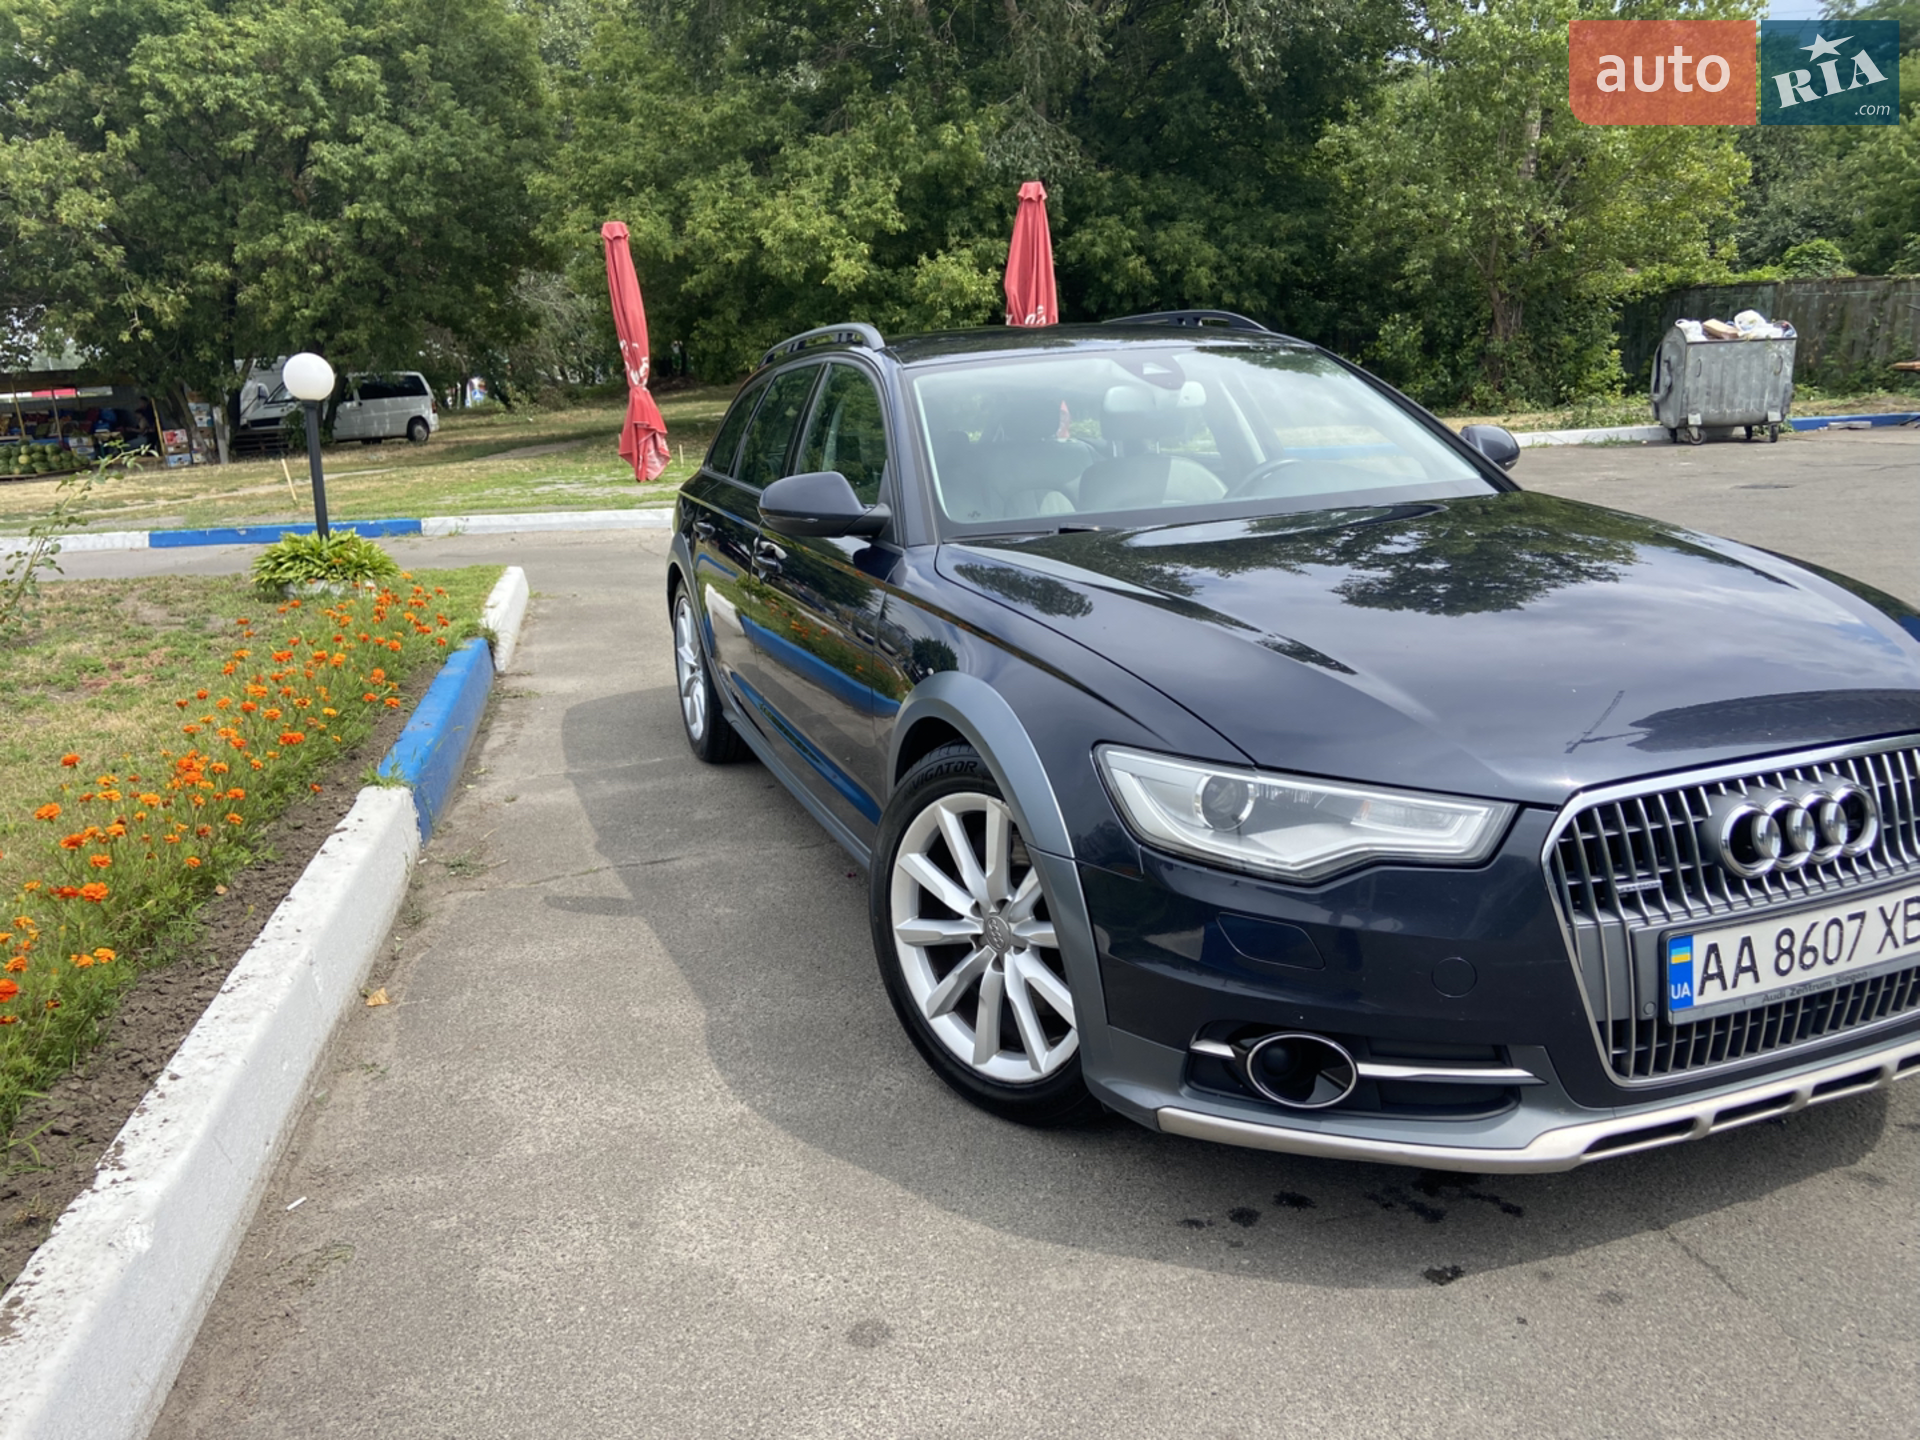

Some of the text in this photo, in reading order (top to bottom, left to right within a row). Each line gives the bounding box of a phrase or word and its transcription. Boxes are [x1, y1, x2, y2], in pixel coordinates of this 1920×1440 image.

[1698, 935, 1760, 997] AA
[1773, 911, 1867, 977] 8607
[1671, 982, 1691, 999] UA
[1762, 971, 1868, 1004] Audi Zentrum Siegen
